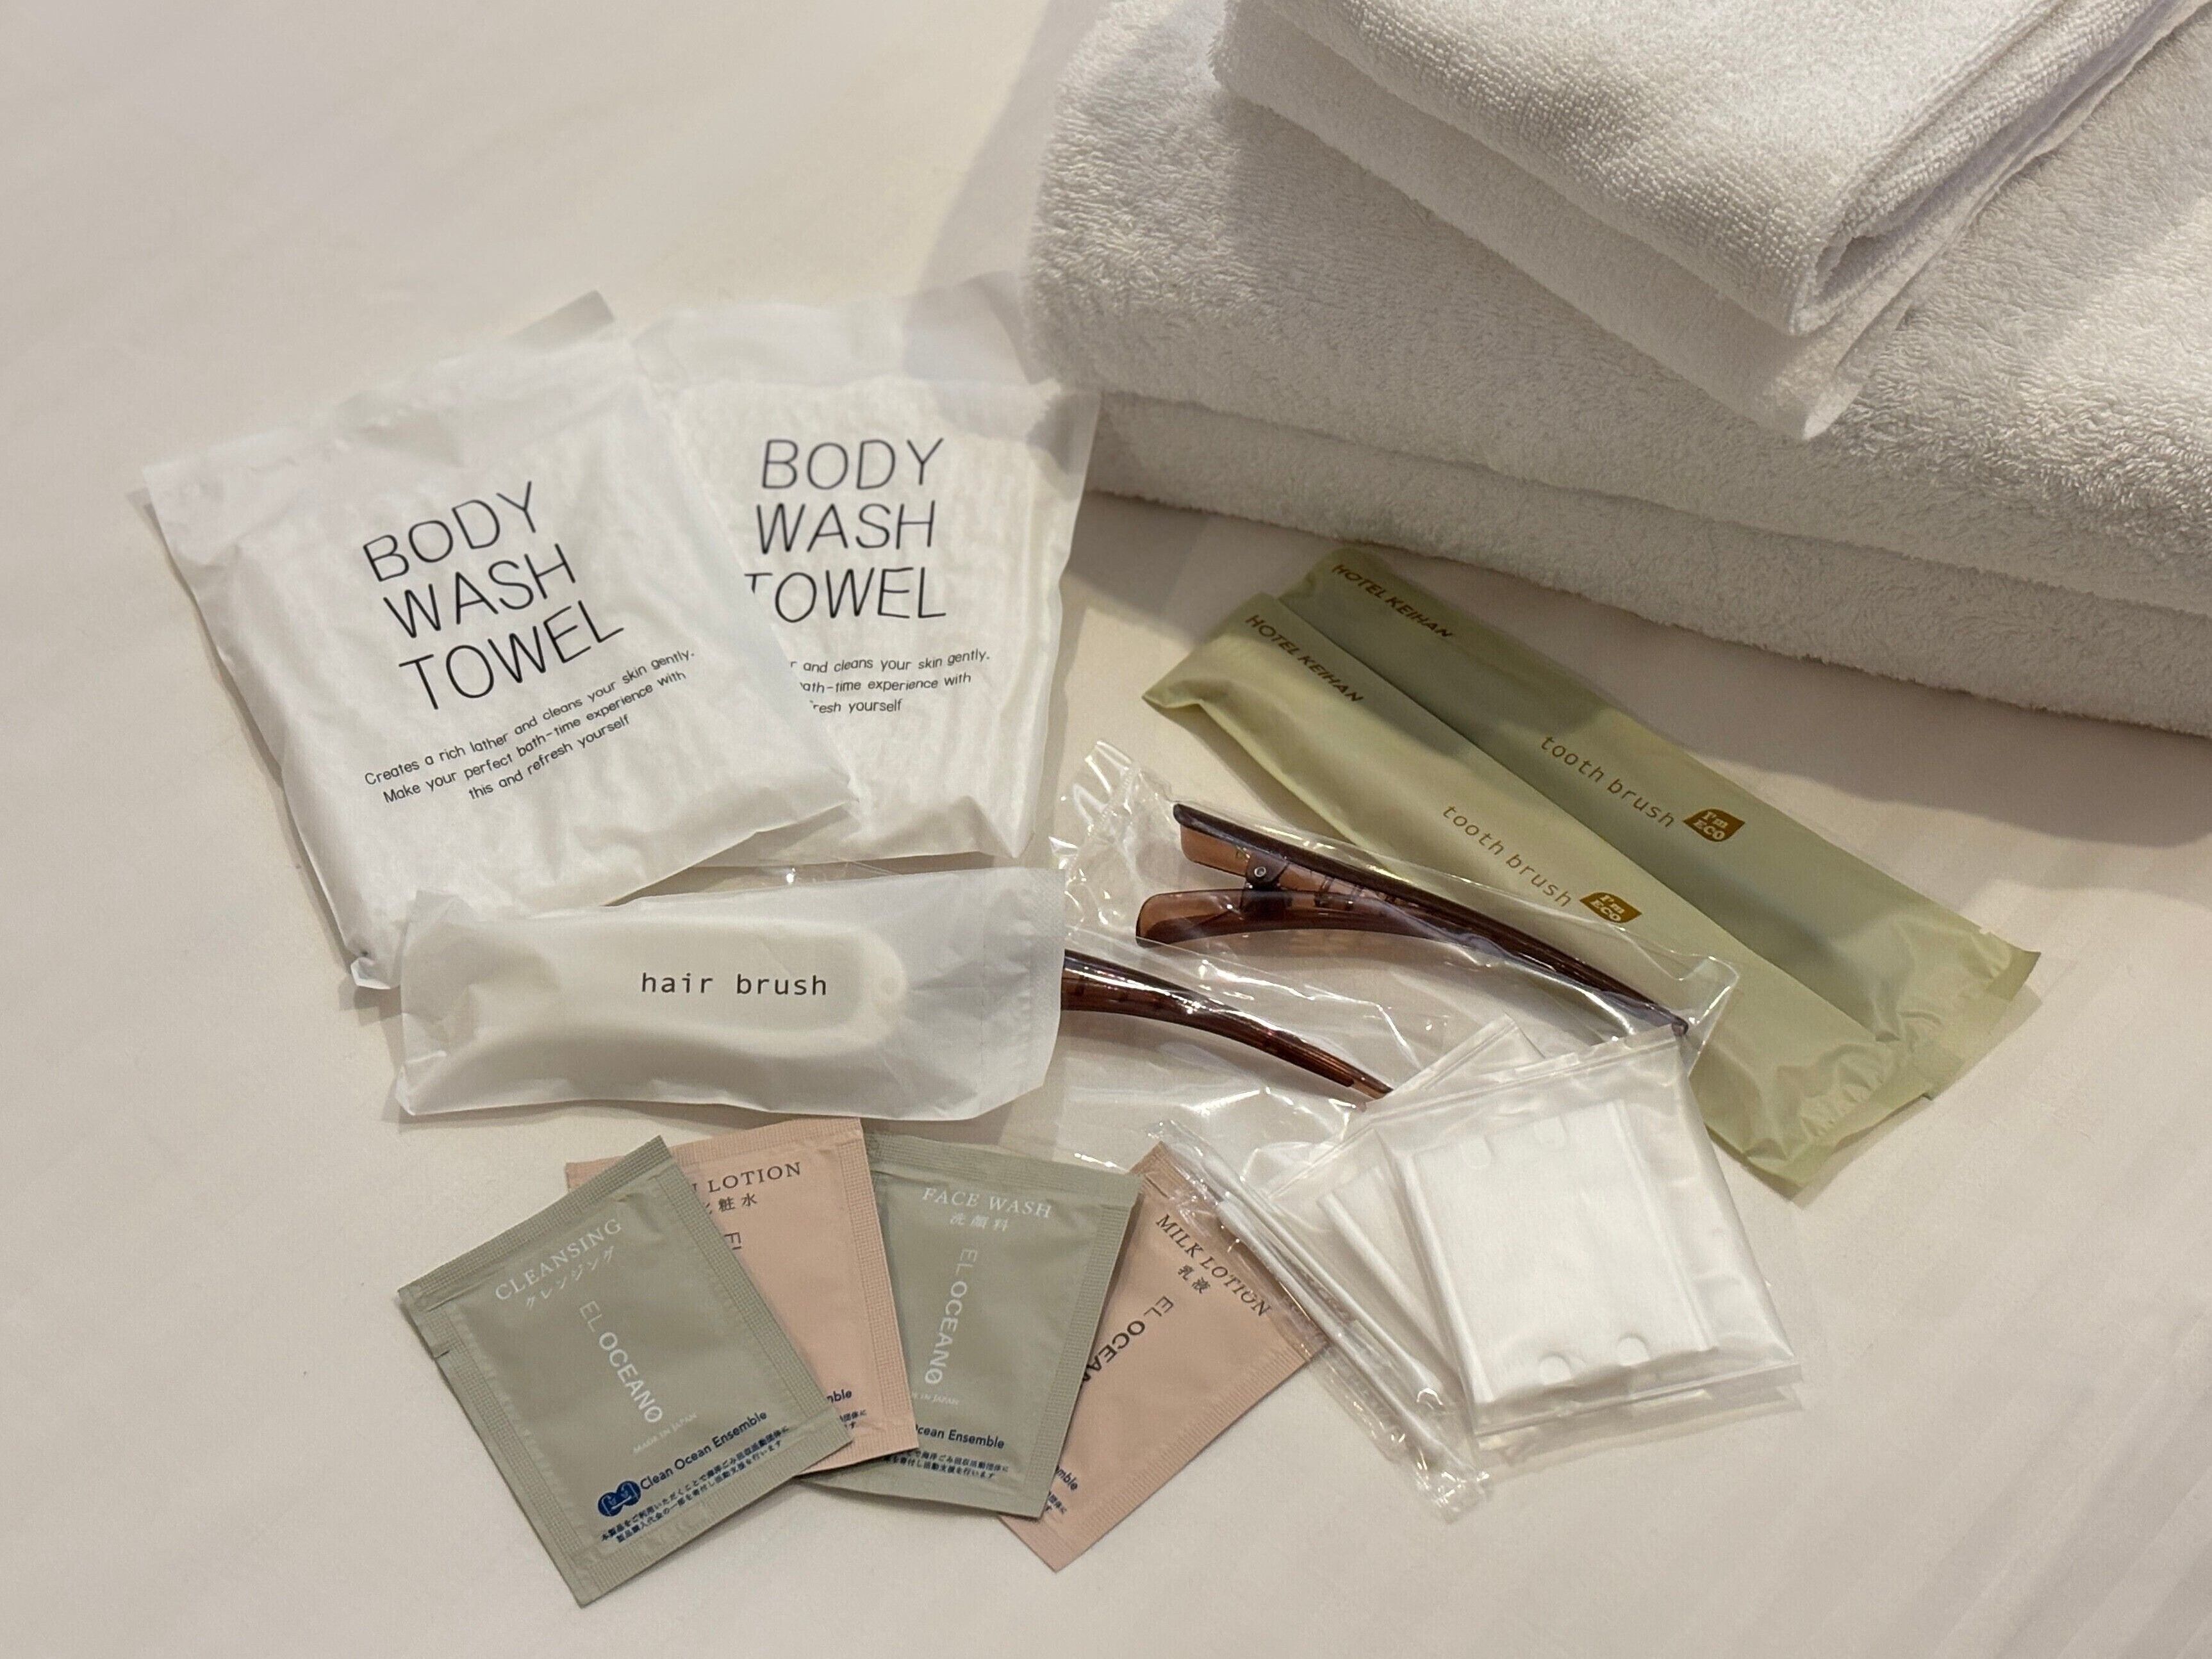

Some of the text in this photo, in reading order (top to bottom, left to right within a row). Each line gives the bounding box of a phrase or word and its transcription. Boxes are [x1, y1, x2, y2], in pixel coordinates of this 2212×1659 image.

[762, 438, 945, 490] BODY
[363, 481, 536, 582] BODY
[757, 500, 936, 555] WASH
[383, 543, 576, 639] WASH
[1332, 563, 1457, 639] HOTEL KEIHAN
[398, 600, 625, 710] TOWEL
[800, 672, 971, 693] ath-time experience with
[803, 661, 828, 673] and
[834, 659, 873, 672] cleans
[880, 659, 912, 672] your
[918, 657, 943, 670] skin
[947, 648, 990, 666] gently.
[1245, 614, 1365, 703] HOTEL KEIHAN
[365, 650, 695, 786] Creates a rich lather and cleans your skin gently.
[383, 670, 687, 803] Make your perfect bath-time experience with
[848, 698, 903, 714] yourself
[468, 713, 631, 800] this and refresh yourself
[1540, 734, 1675, 829] tooth brush
[1442, 805, 1573, 907] tooth brush
[641, 972, 827, 995] hair brush
[707, 1162, 801, 1193] LOTION
[921, 1187, 1052, 1218] FACE WASH
[495, 1219, 622, 1301] CLEANSING
[527, 1246, 615, 1311] クレンジング
[1155, 1214, 1273, 1317] MILK LOTION
[1178, 1264, 1211, 1294] 乳液
[925, 1248, 978, 1385] EL OCEANO
[1143, 1295, 1175, 1317] EL
[579, 1300, 663, 1423] EL OCEANO
[640, 1411, 768, 1490] Clean Ocean Ensemble
[915, 1423, 1005, 1449] cean Ensemble
